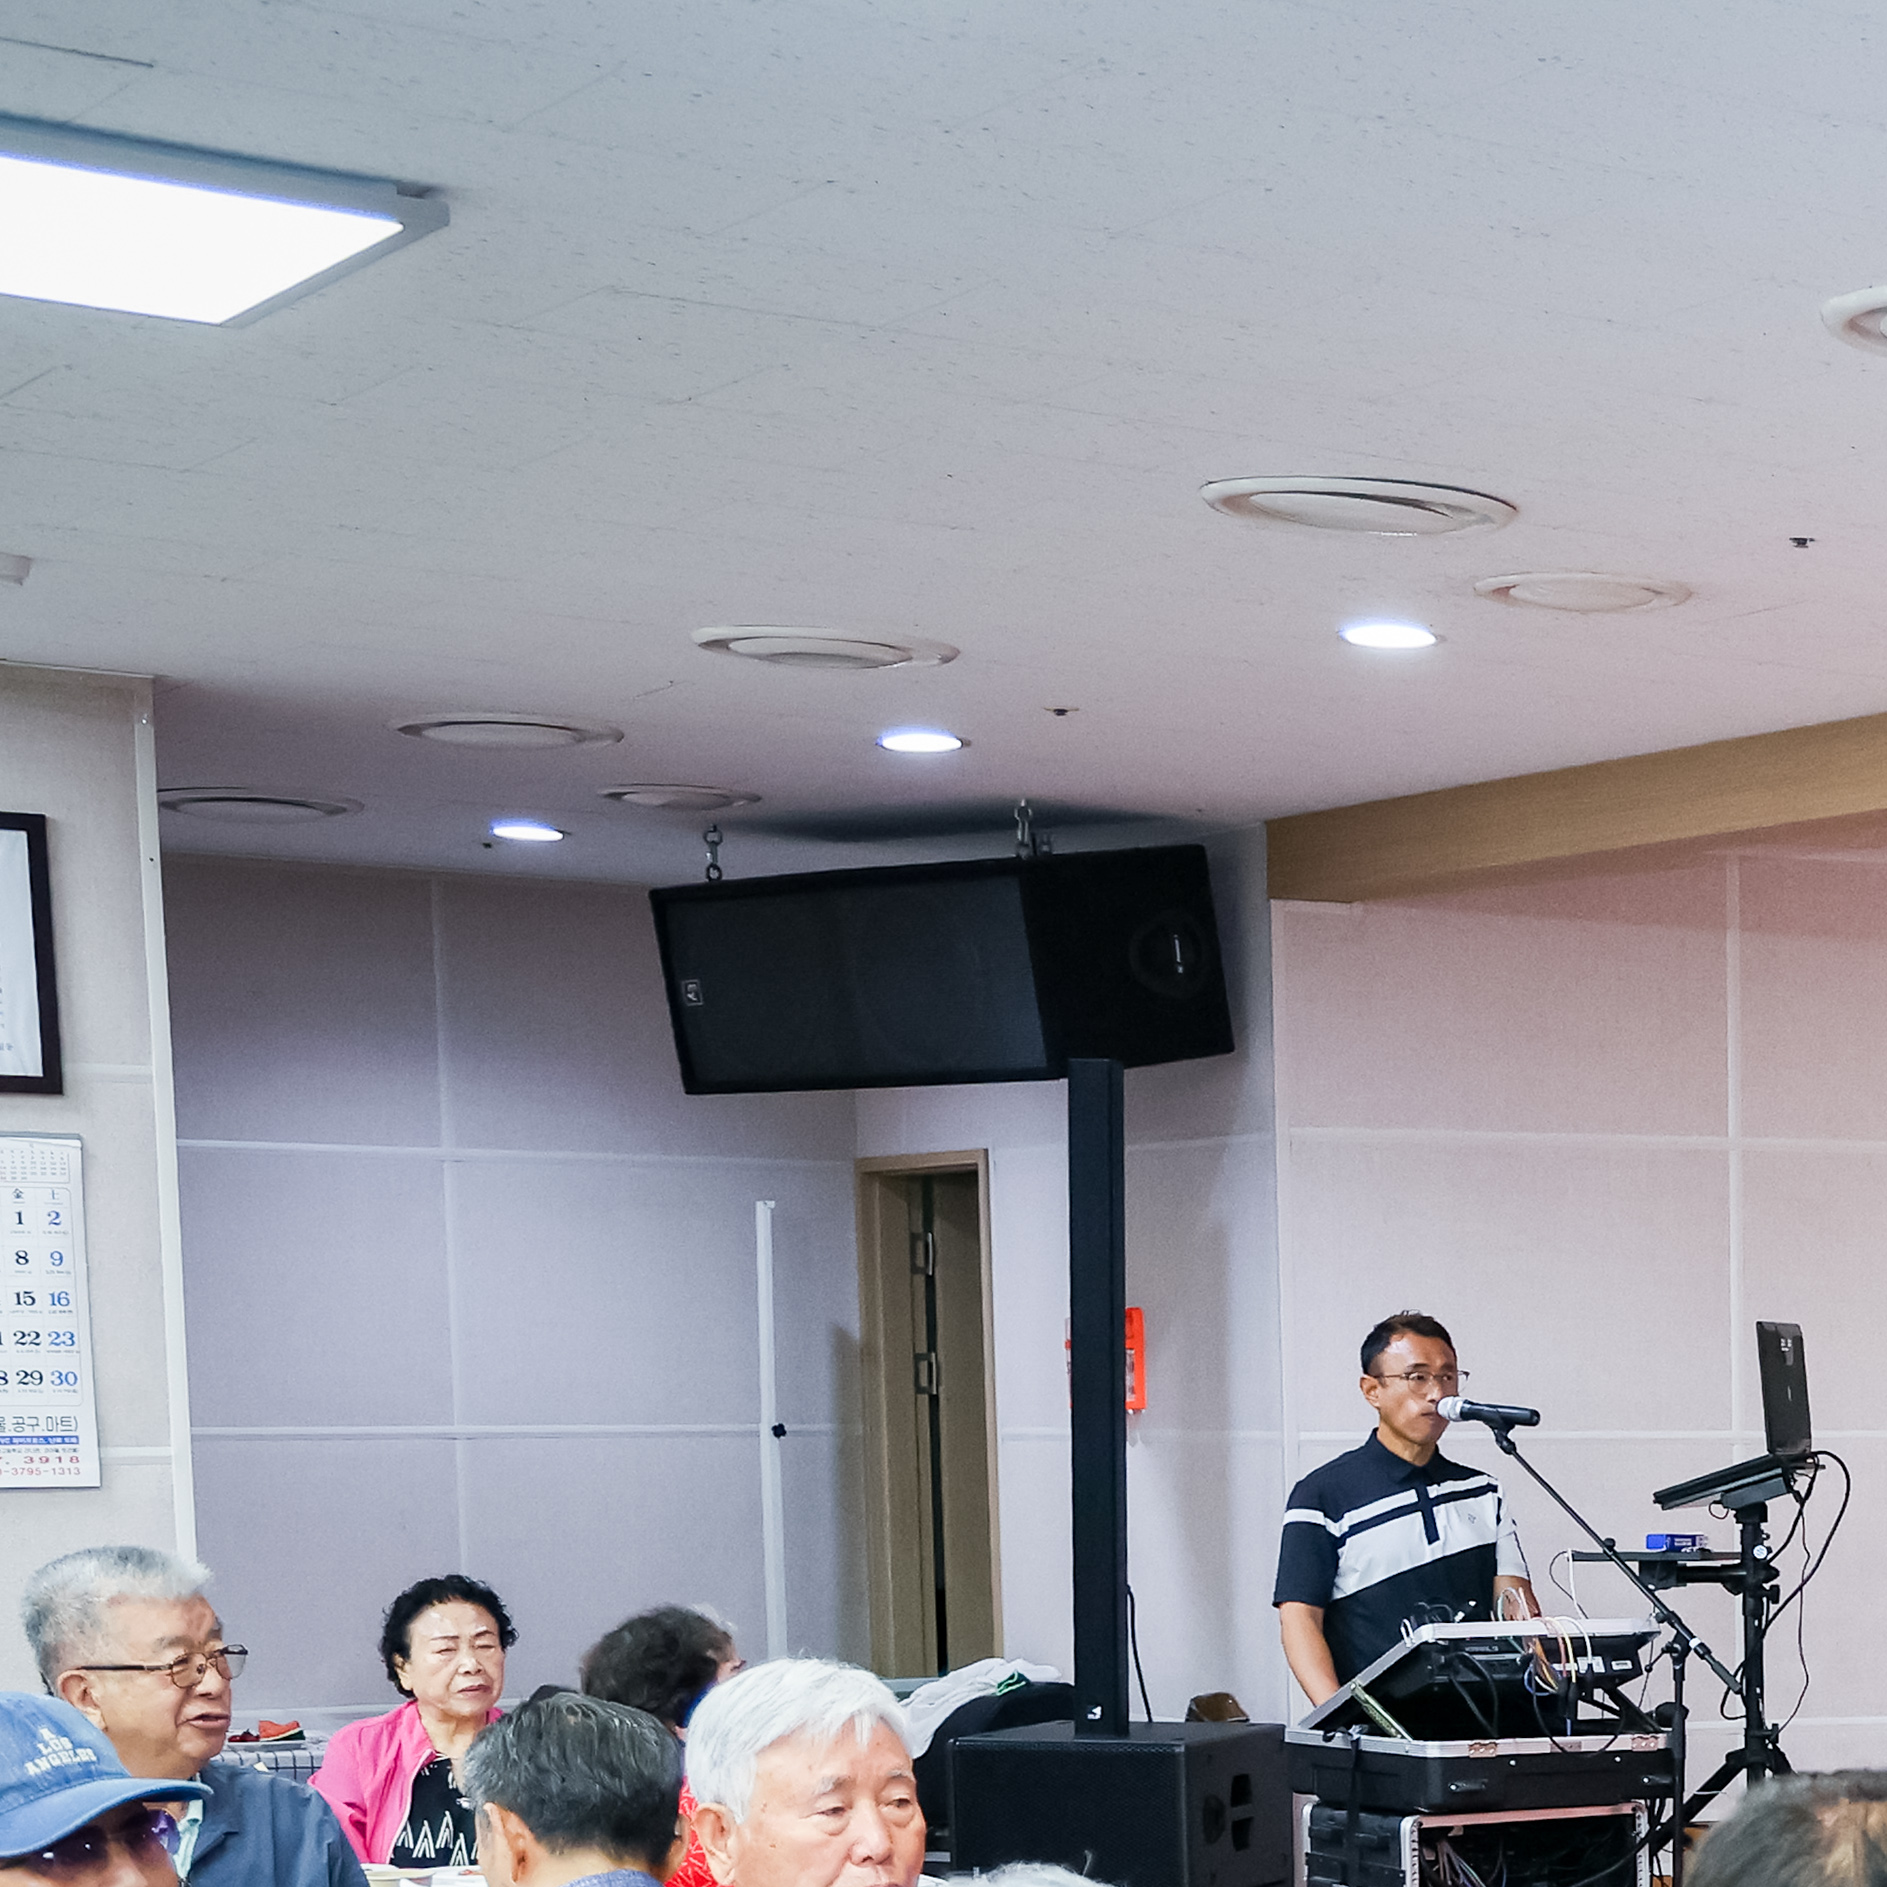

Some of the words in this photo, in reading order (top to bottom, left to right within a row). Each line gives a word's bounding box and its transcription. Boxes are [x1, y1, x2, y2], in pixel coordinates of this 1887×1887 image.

[15, 1210, 24, 1225] 1
[47, 1210, 62, 1226] 2
[15, 1249, 30, 1265] 8
[50, 1250, 64, 1267] 9
[14, 1290, 36, 1307] 15
[48, 1290, 70, 1307] 16
[13, 1330, 41, 1346] 22
[47, 1330, 75, 1347] 23
[15, 1369, 43, 1386] 29
[50, 1369, 78, 1386] 30
[0, 1466, 81, 1476] -3795-1313
[37, 1737, 73, 1755] LOS
[24, 1747, 97, 1777] ANGELES
